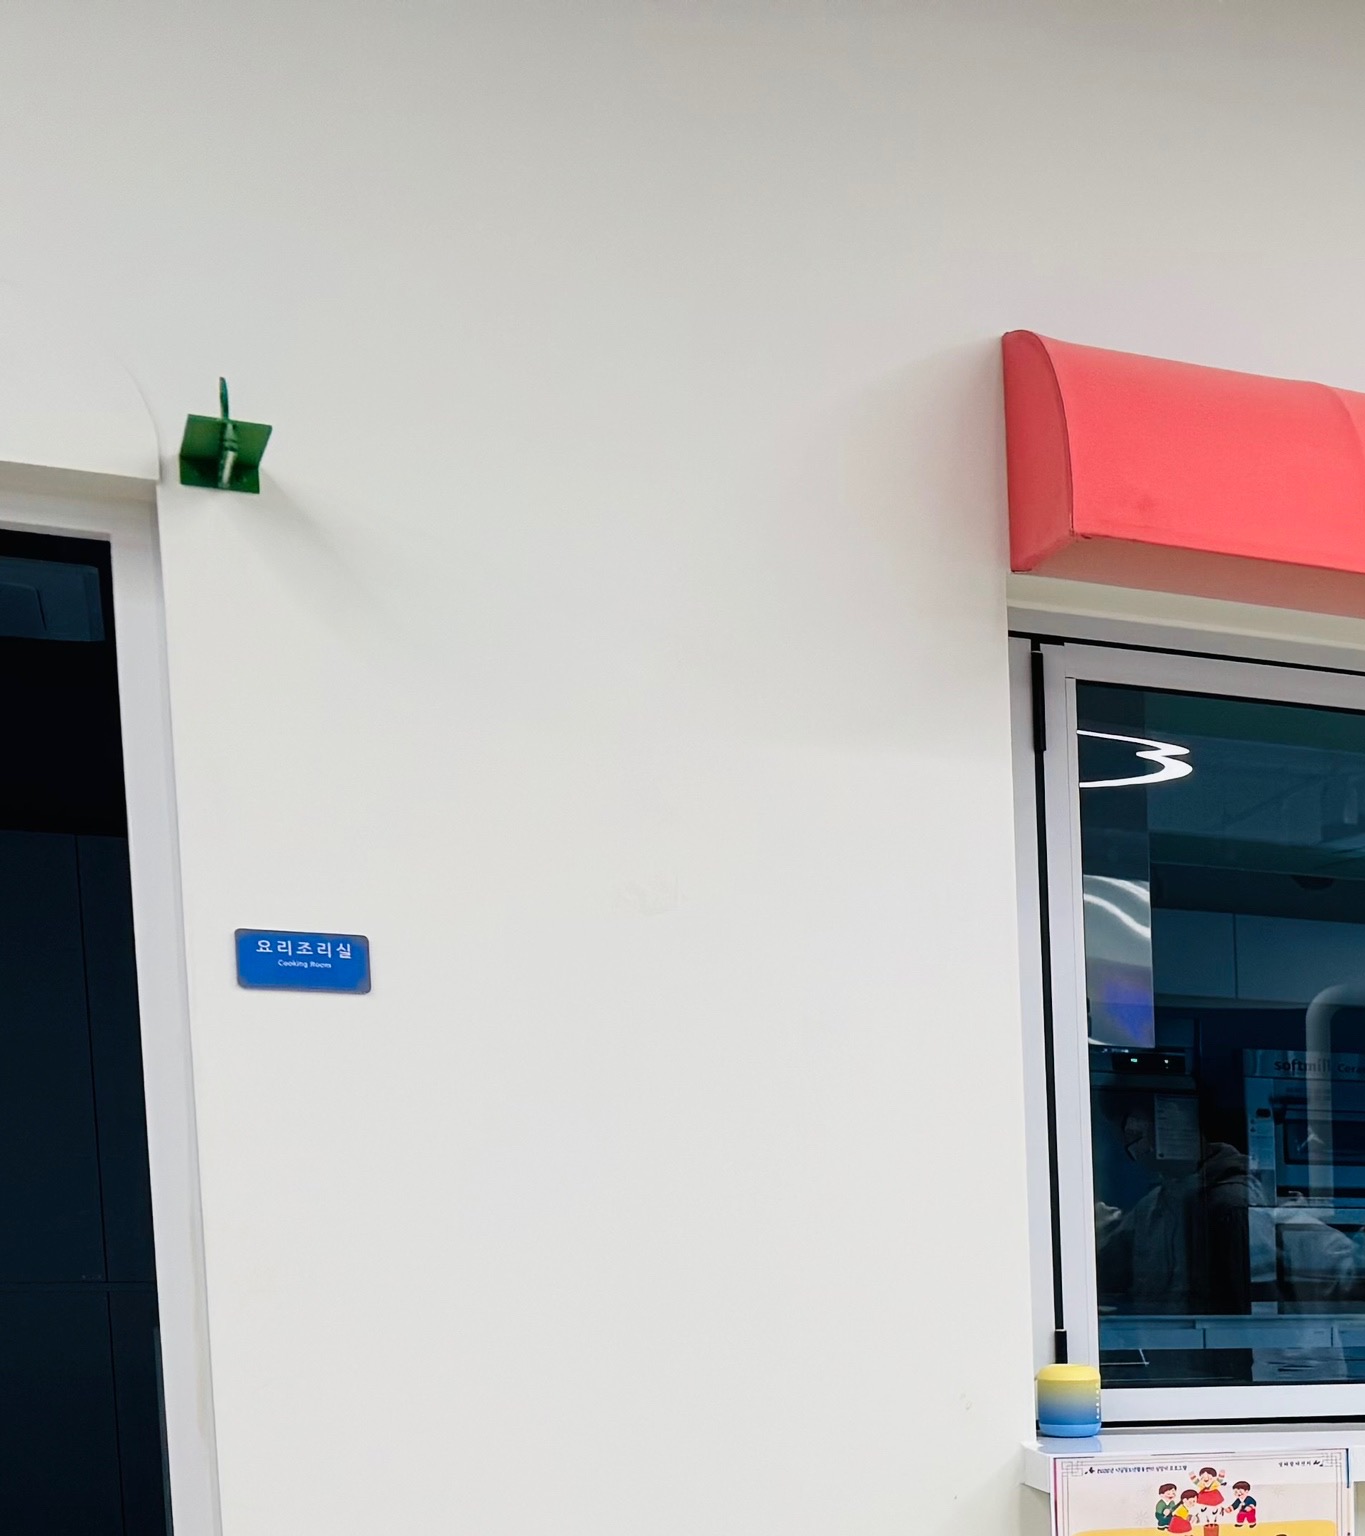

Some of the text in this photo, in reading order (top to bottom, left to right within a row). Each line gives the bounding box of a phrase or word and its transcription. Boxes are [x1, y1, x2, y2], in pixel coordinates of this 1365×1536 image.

[256, 939, 352, 959] 요리조리실
[278, 959, 332, 969] Cooking Room
